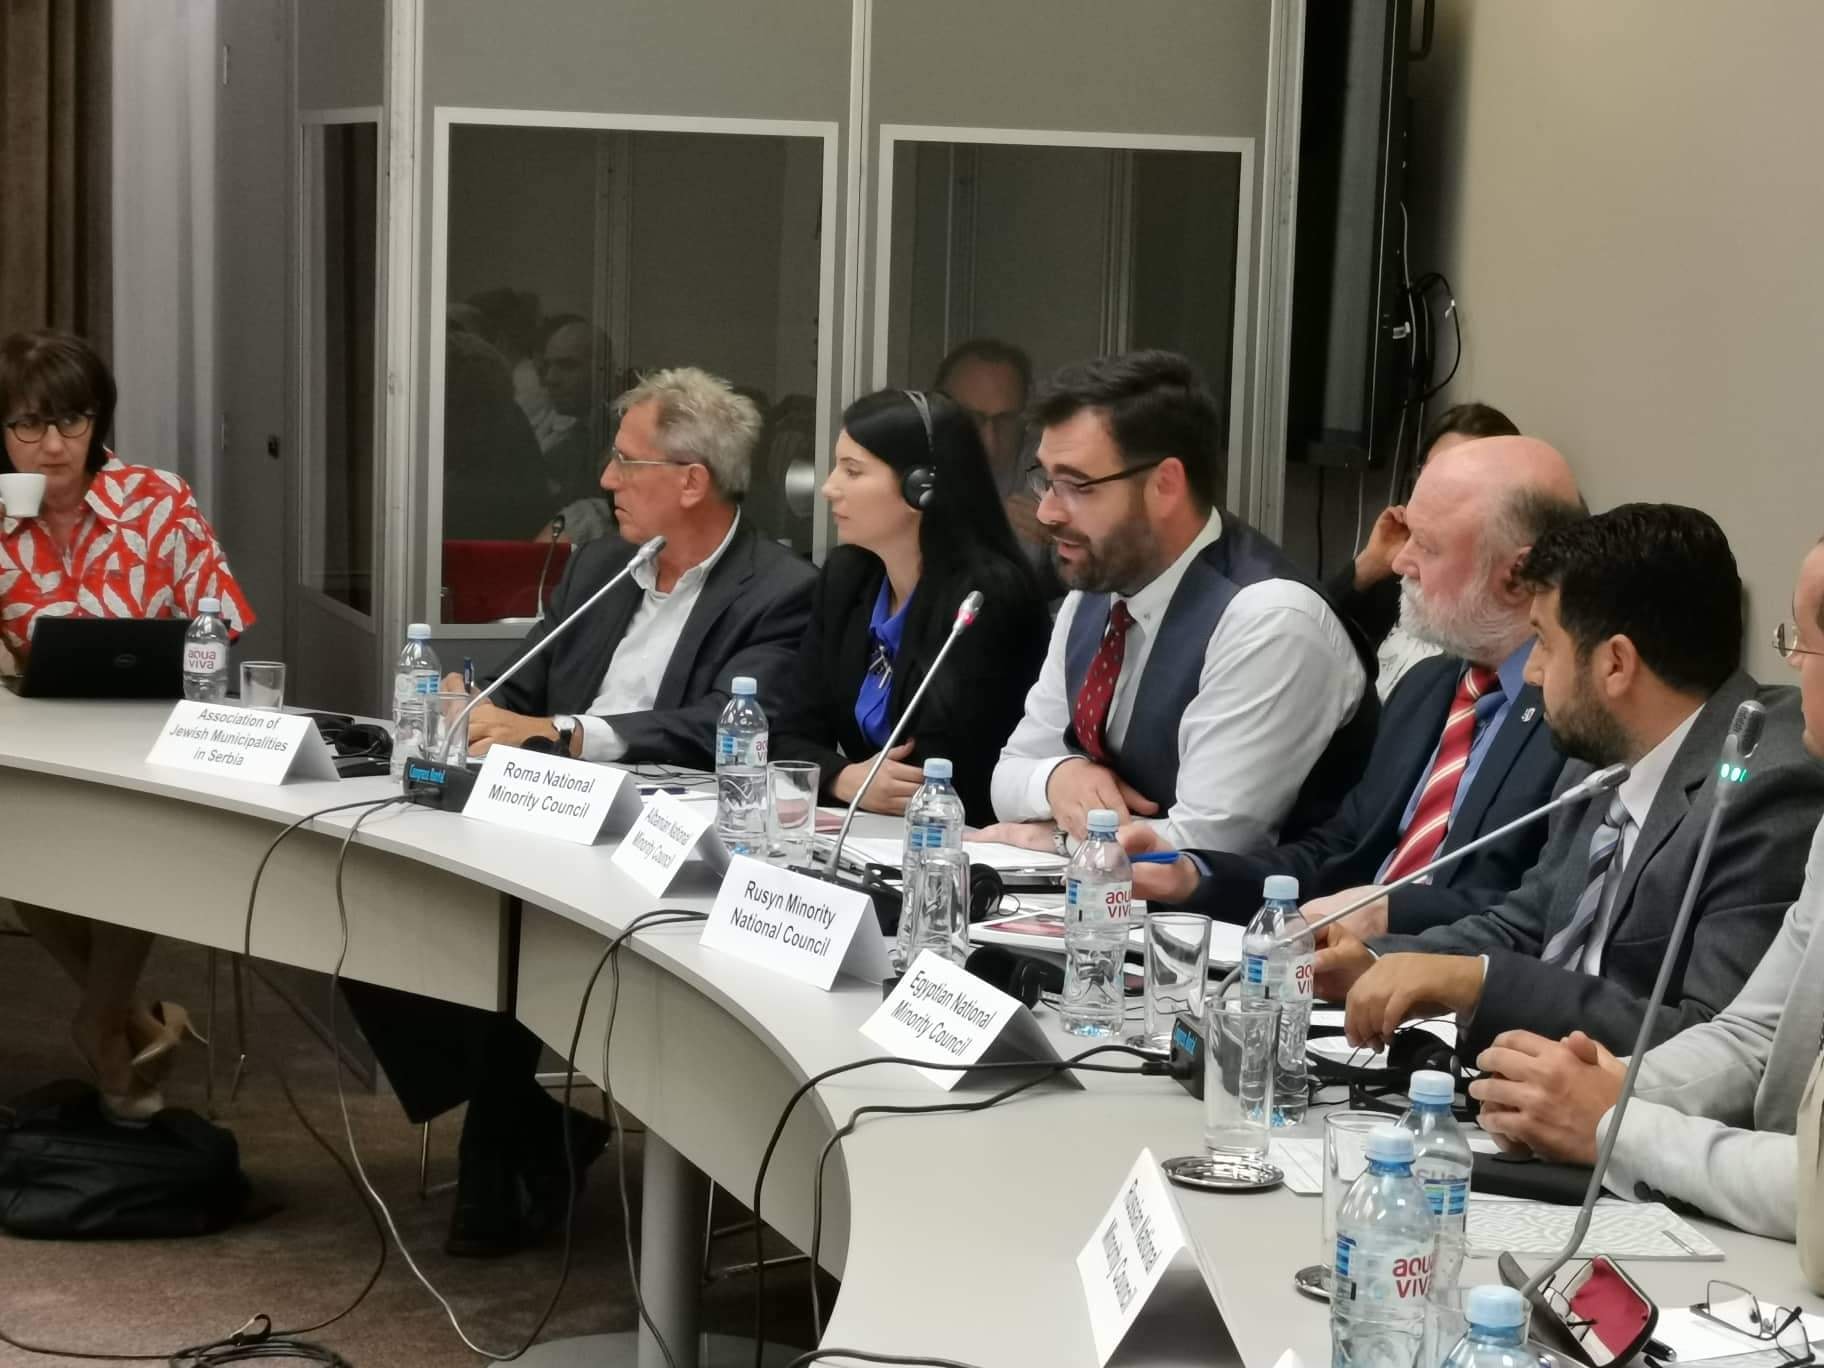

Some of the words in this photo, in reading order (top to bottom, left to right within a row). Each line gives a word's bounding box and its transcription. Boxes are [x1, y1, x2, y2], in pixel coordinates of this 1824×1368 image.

[189, 660, 214, 669] viva
[198, 708, 264, 729] Association
[266, 717, 282, 729] of
[169, 724, 209, 740] Jewish
[211, 728, 288, 752] Municipalities
[193, 747, 206, 760] in
[208, 749, 244, 766] Serbia
[503, 761, 541, 783] Roma
[543, 769, 596, 793] National
[488, 784, 541, 811] Minority
[541, 796, 590, 818] Council
[632, 831, 656, 859] Minority
[652, 844, 677, 868] Council
[744, 880, 784, 910] Rusyn
[785, 893, 836, 930] Minority
[730, 907, 783, 940] National
[783, 925, 831, 957] Council
[910, 970, 954, 1007] Egyptian
[950, 991, 998, 1030] National
[890, 1000, 930, 1039] Minority
[928, 1021, 973, 1056] Council
[1391, 1256, 1432, 1278] aqu
